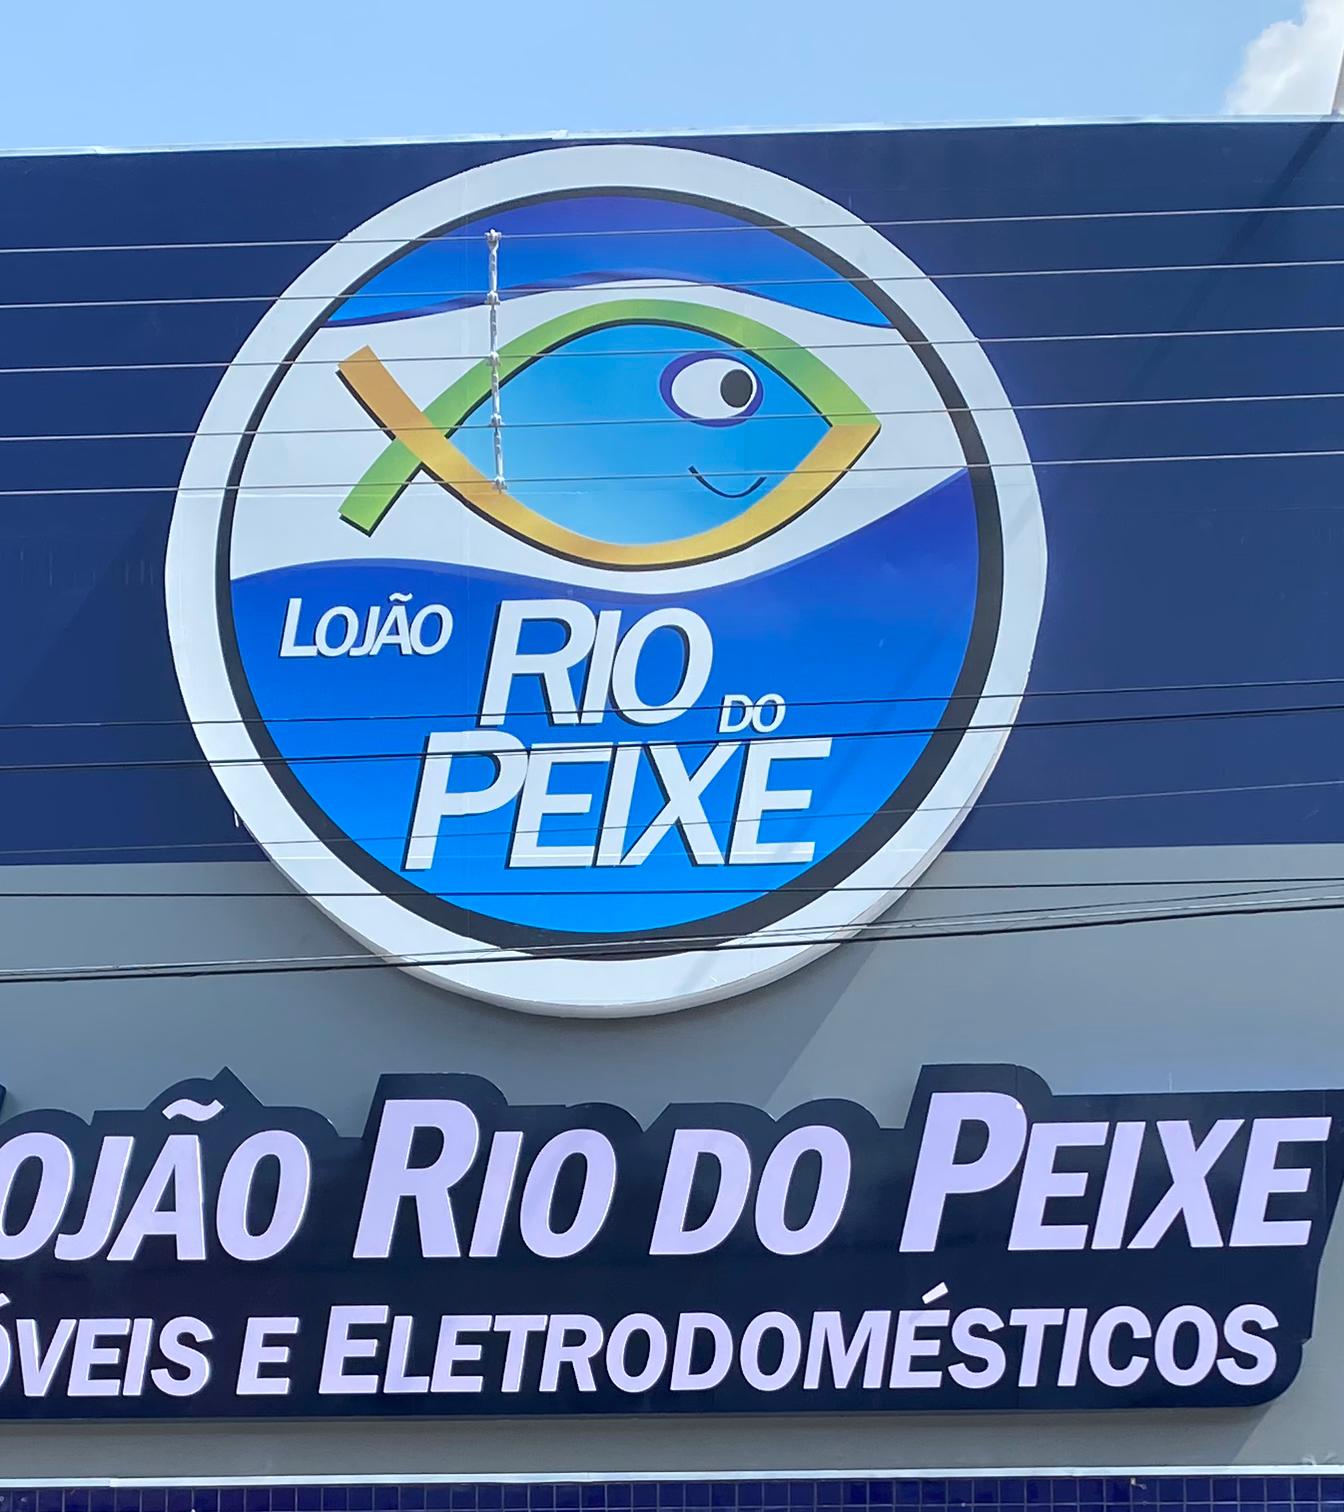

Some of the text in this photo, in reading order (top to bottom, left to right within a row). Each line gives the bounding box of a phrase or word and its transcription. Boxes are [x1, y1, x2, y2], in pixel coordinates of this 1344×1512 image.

[279, 592, 453, 659] LOJÃO
[479, 599, 785, 735] RIO DO
[403, 731, 832, 871] PEIXE
[351, 1093, 618, 1260] RIO
[648, 1127, 854, 1257] DO
[901, 1091, 1334, 1254] PEIXE
[237, 1315, 302, 1395] E
[318, 1284, 1279, 1396] ELETRODOMÉSTICOS
